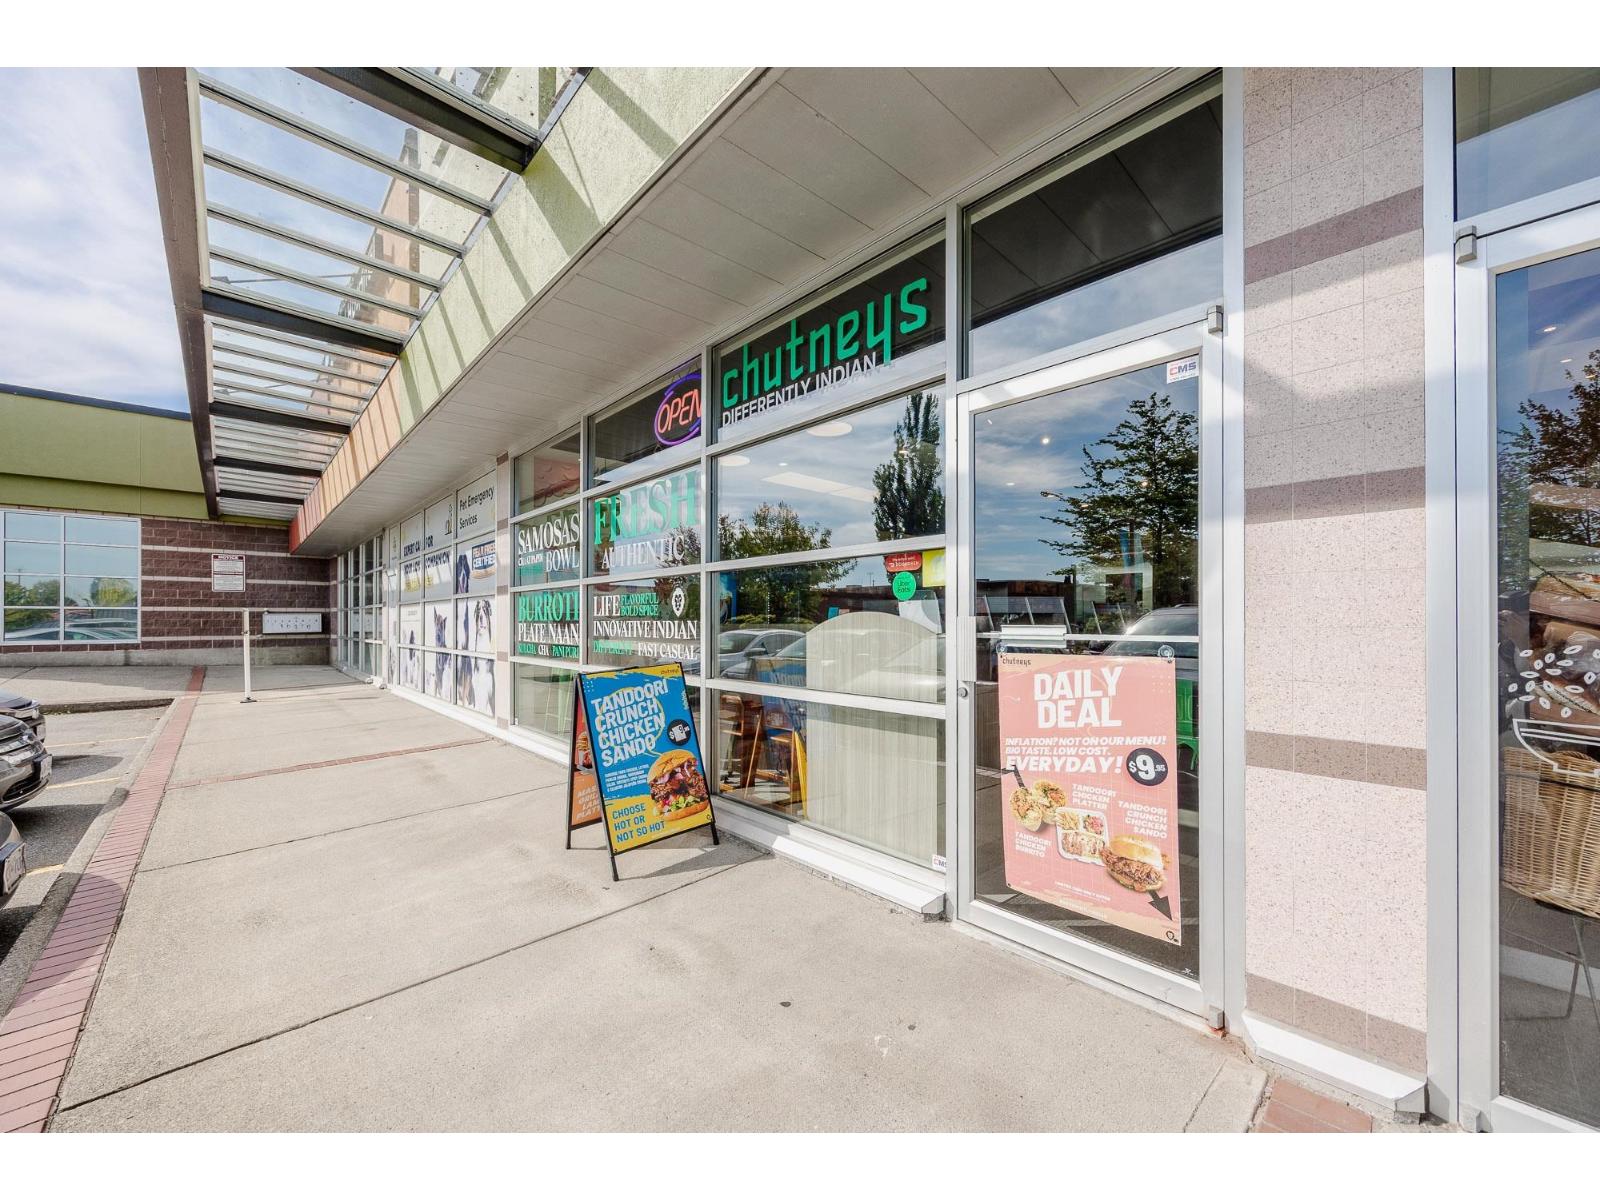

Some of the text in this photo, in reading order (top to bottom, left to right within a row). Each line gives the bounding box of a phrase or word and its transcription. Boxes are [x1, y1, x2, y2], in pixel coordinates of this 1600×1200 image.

[723, 277, 928, 408] chutneys
[722, 352, 877, 427] DIFFERENTLY INDIAN
[657, 388, 702, 434] OPEN
[467, 486, 495, 508] Emergency
[594, 470, 699, 545] FRESH
[459, 513, 478, 530] Services
[518, 513, 580, 555] SAMOSAS
[545, 545, 580, 572] BOWL
[601, 535, 685, 569] AUTHENTIC
[593, 595, 620, 617] LIFE
[518, 623, 579, 646] PLATE NAAN
[593, 620, 698, 640] INNOVATIVE INDIAN
[638, 642, 698, 660] FAST CASUAL
[1034, 666, 1123, 701] DAILY
[590, 679, 669, 715] TANDOORI
[595, 699, 659, 732] CRUNCH
[1037, 697, 1122, 729] DEAL
[598, 713, 666, 750] CHICKEN
[1005, 735, 1167, 746] INFLATION? NOT ON OUR MENU!
[601, 734, 656, 767] SANDO
[1053, 747, 1079, 755] LOW
[1072, 784, 1117, 798] TANDOORI
[1072, 791, 1110, 803] CHICKEN
[612, 803, 647, 820] CHOOSE
[1072, 797, 1108, 810] PLATTER
[1118, 801, 1167, 815] TANDOORI
[614, 815, 646, 831] HOT OR
[1125, 817, 1168, 831] CHICKEN
[1127, 810, 1167, 824] CRUNCH
[616, 820, 665, 843] NOT SO HOT
[1133, 827, 1167, 839] SANDO
